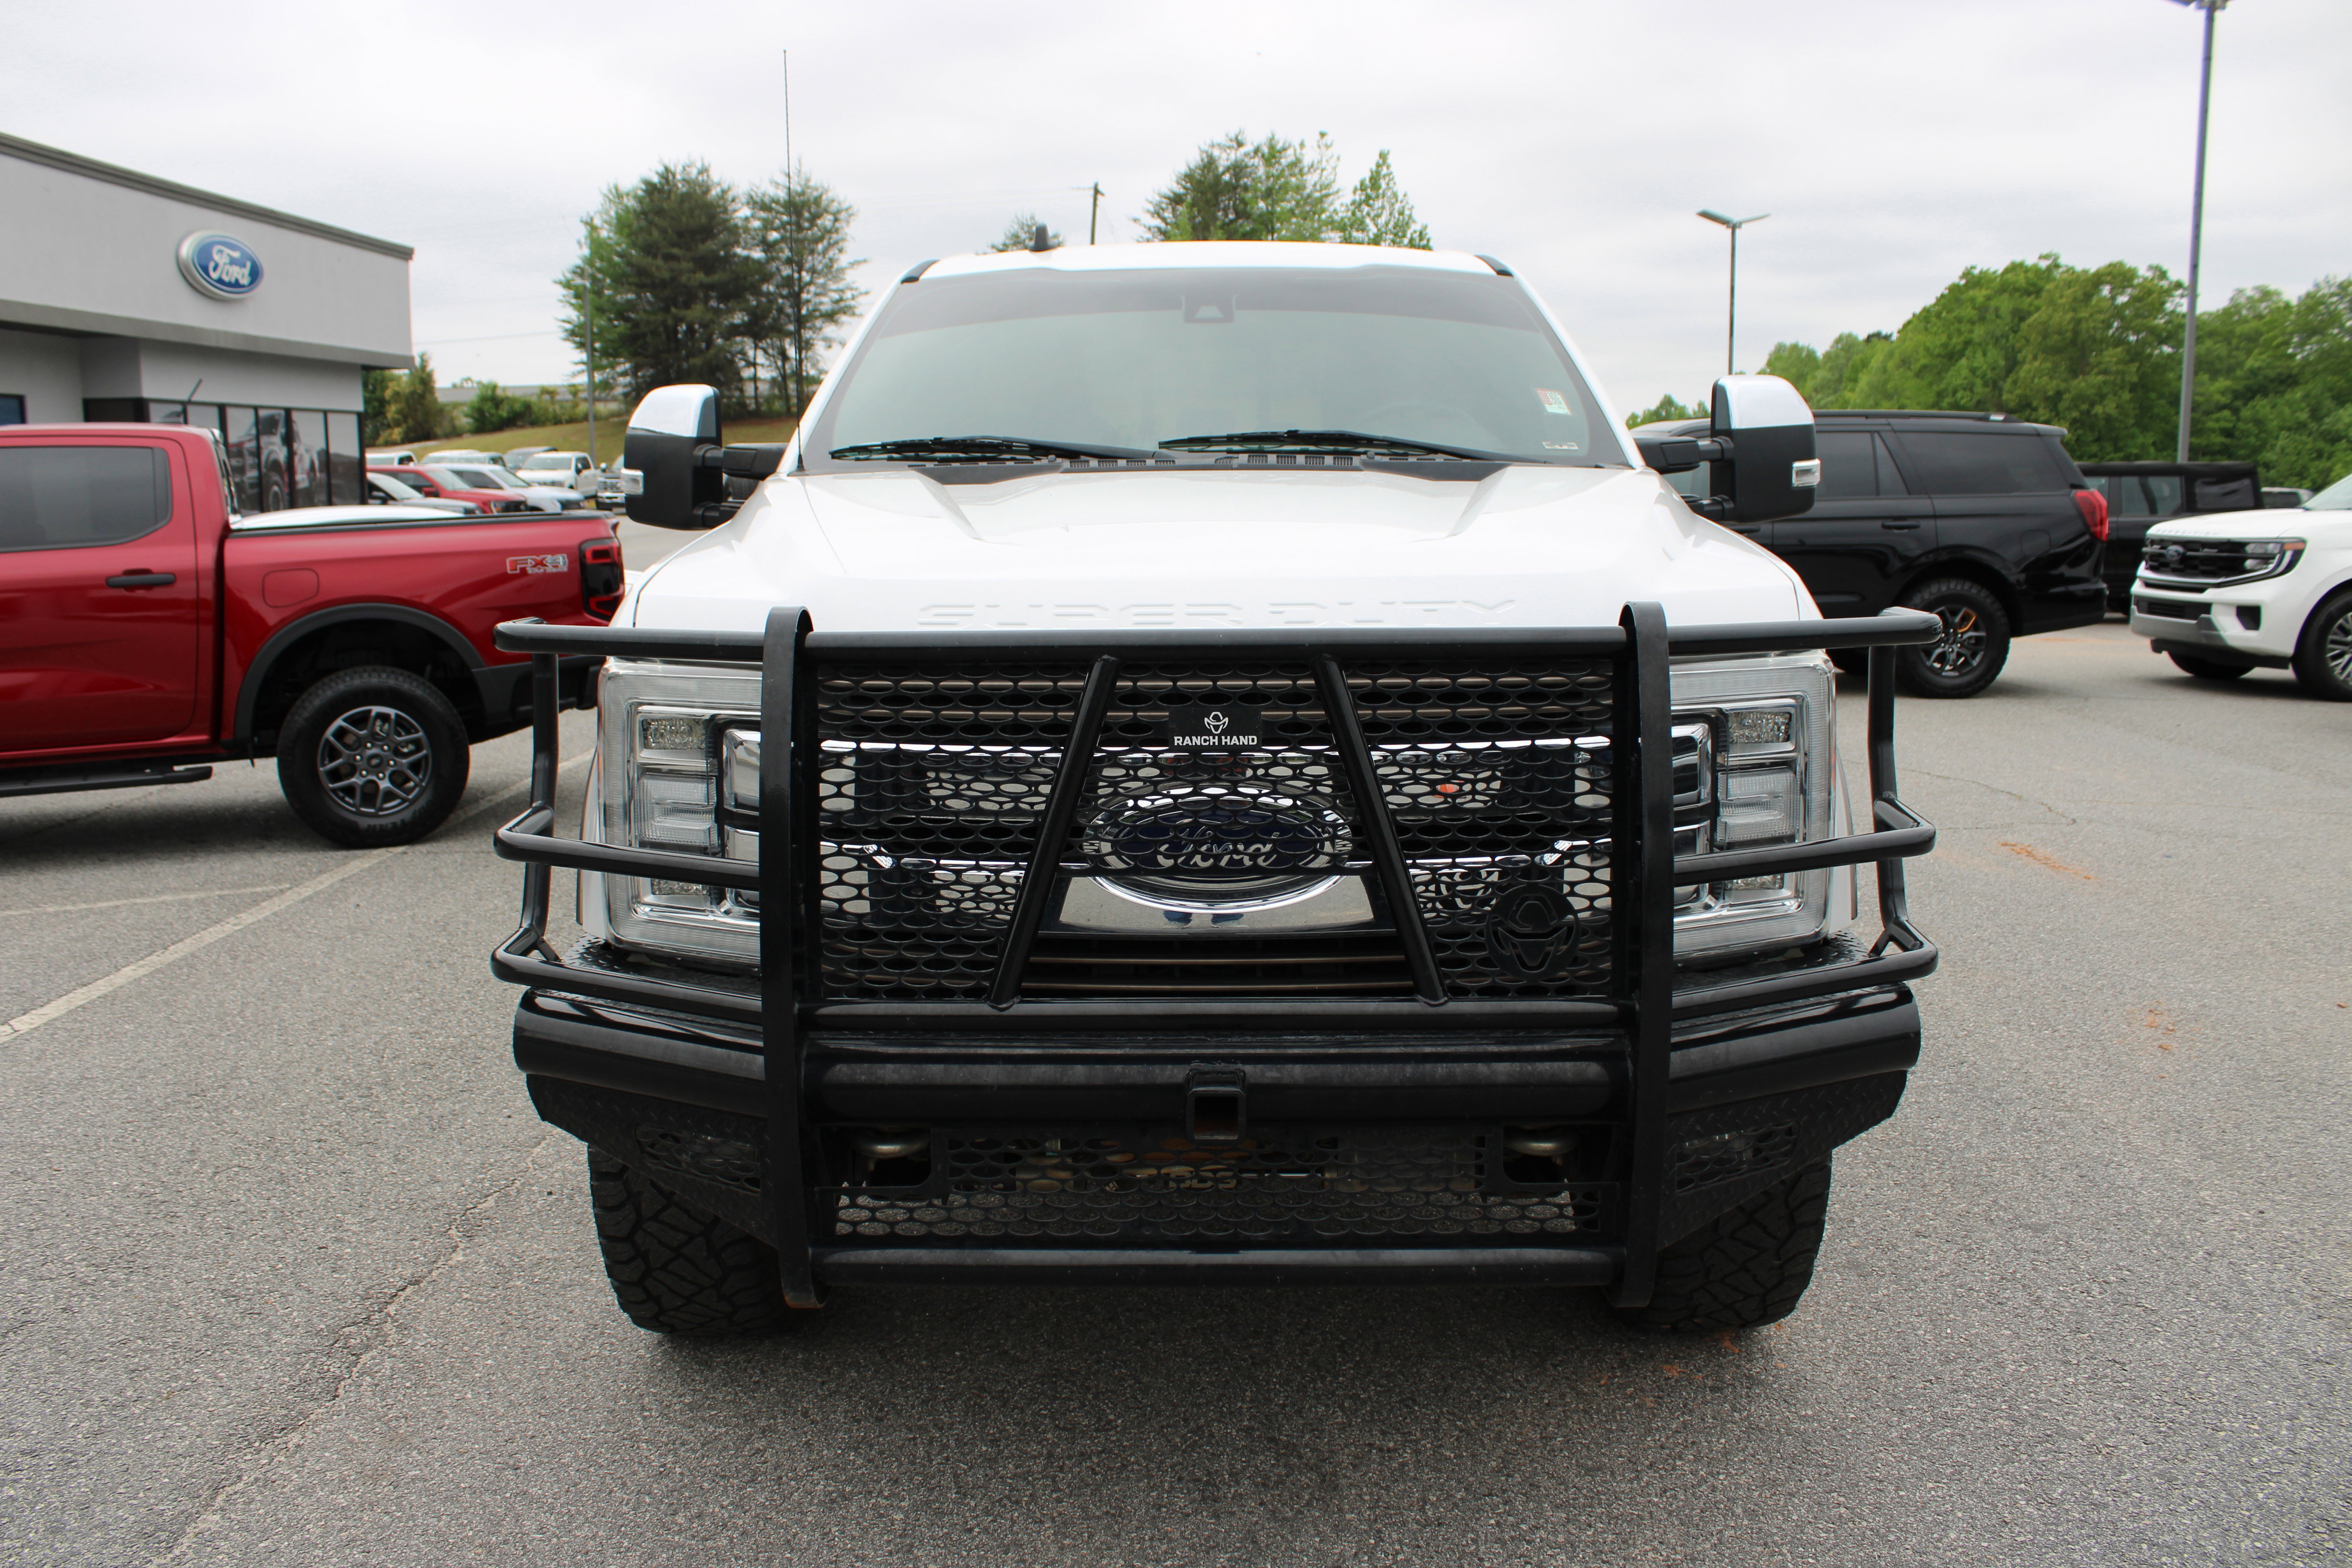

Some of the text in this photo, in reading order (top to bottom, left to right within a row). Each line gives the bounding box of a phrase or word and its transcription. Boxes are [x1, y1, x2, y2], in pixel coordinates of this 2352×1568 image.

[208, 245, 252, 286] Ford
[506, 554, 568, 573] FX4
[917, 599, 1516, 629] SUPER DUTY
[1174, 736, 1257, 746] RANCH HAND
